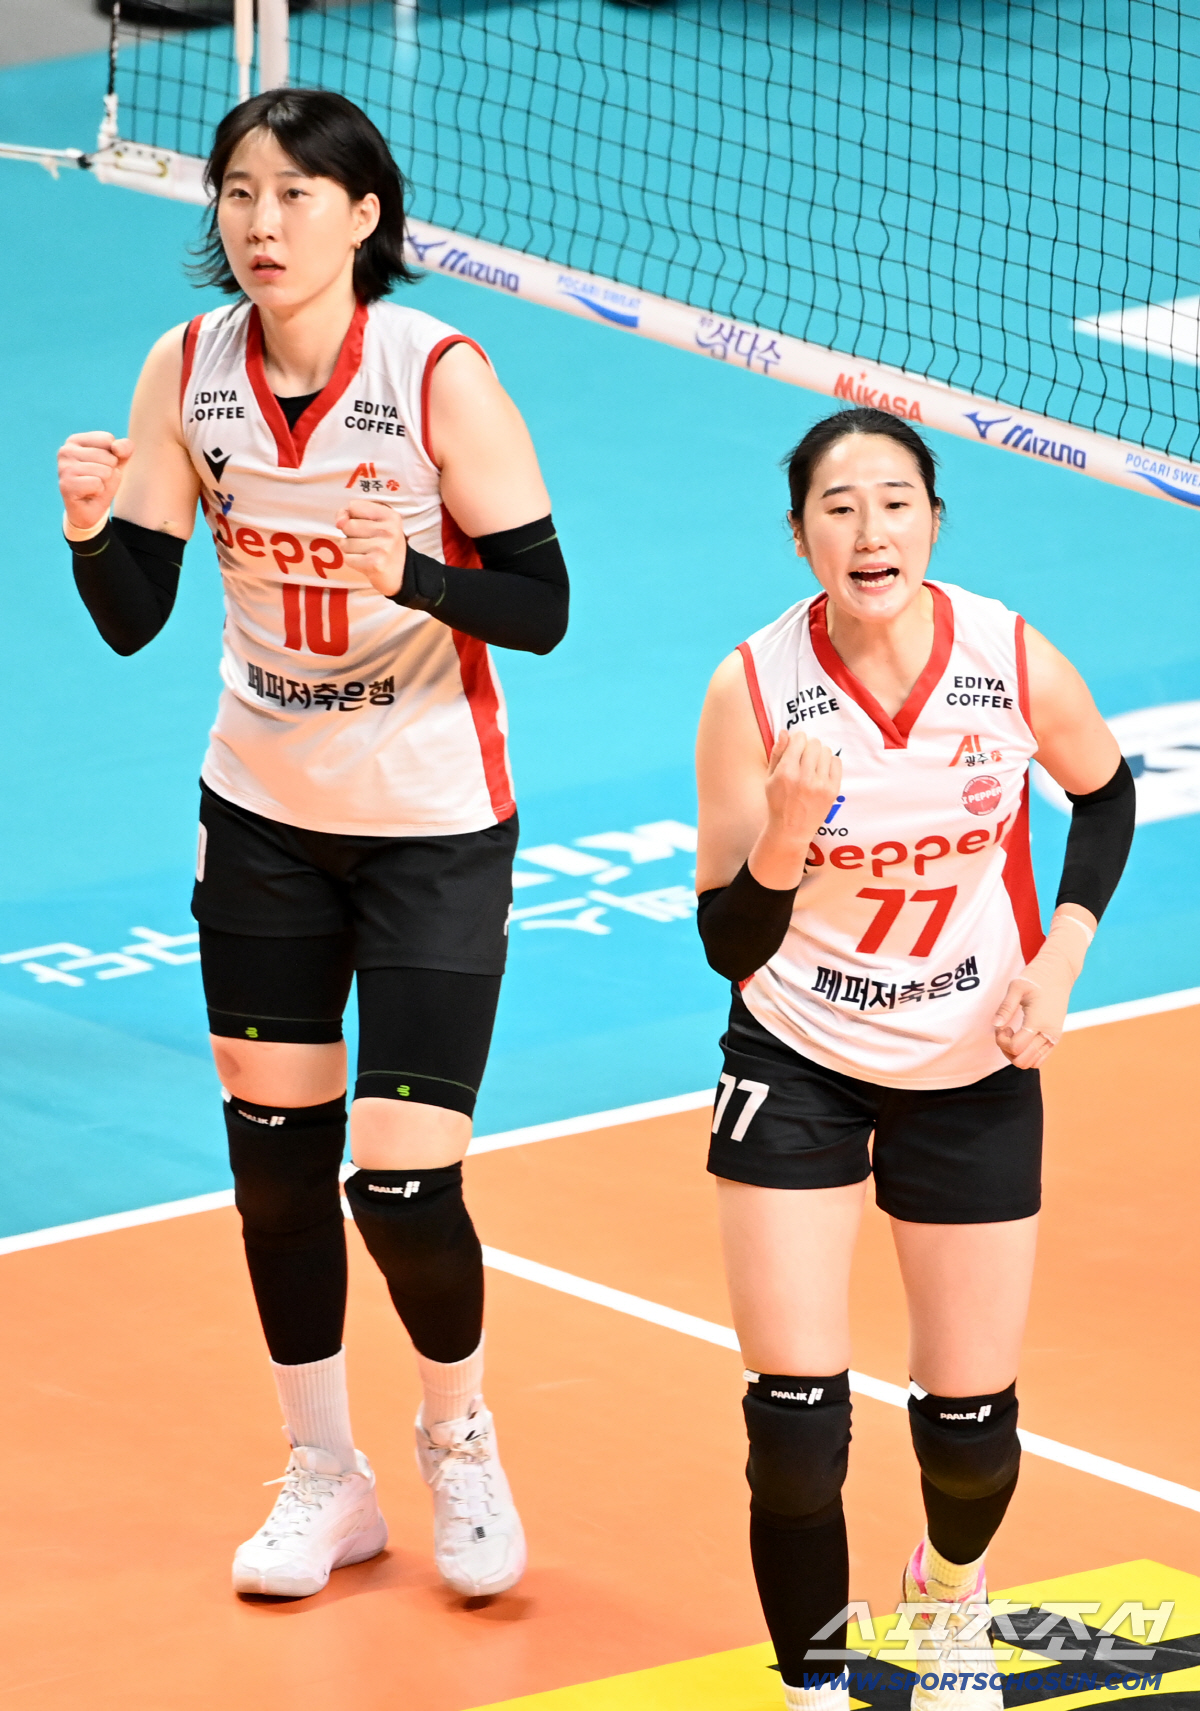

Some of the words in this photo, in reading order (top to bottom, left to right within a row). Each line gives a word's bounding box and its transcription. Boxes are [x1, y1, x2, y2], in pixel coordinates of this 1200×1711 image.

[695, 322, 782, 375] 삼다수
[189, 406, 245, 423] OFFEE
[354, 399, 398, 420] EDIYA
[344, 416, 406, 438] COFFEE
[1125, 452, 1171, 478] POCARI
[1172, 467, 1200, 488] SWE
[359, 479, 384, 493] 광주
[215, 513, 344, 579] pepp
[282, 582, 350, 657] 10
[247, 661, 396, 712] 페퍼저축은행
[953, 676, 1006, 693] EDIYA
[786, 684, 828, 714] EIYA
[946, 692, 1014, 710] COFFEE
[815, 826, 849, 837] OVO
[855, 884, 958, 958] 77
[811, 956, 981, 1011] 페퍼저축은행
[711, 1072, 770, 1142] 77
[368, 1183, 404, 1195] PAALIK
[771, 1390, 808, 1401] PAALIK
[940, 1412, 977, 1421] PAALIK
